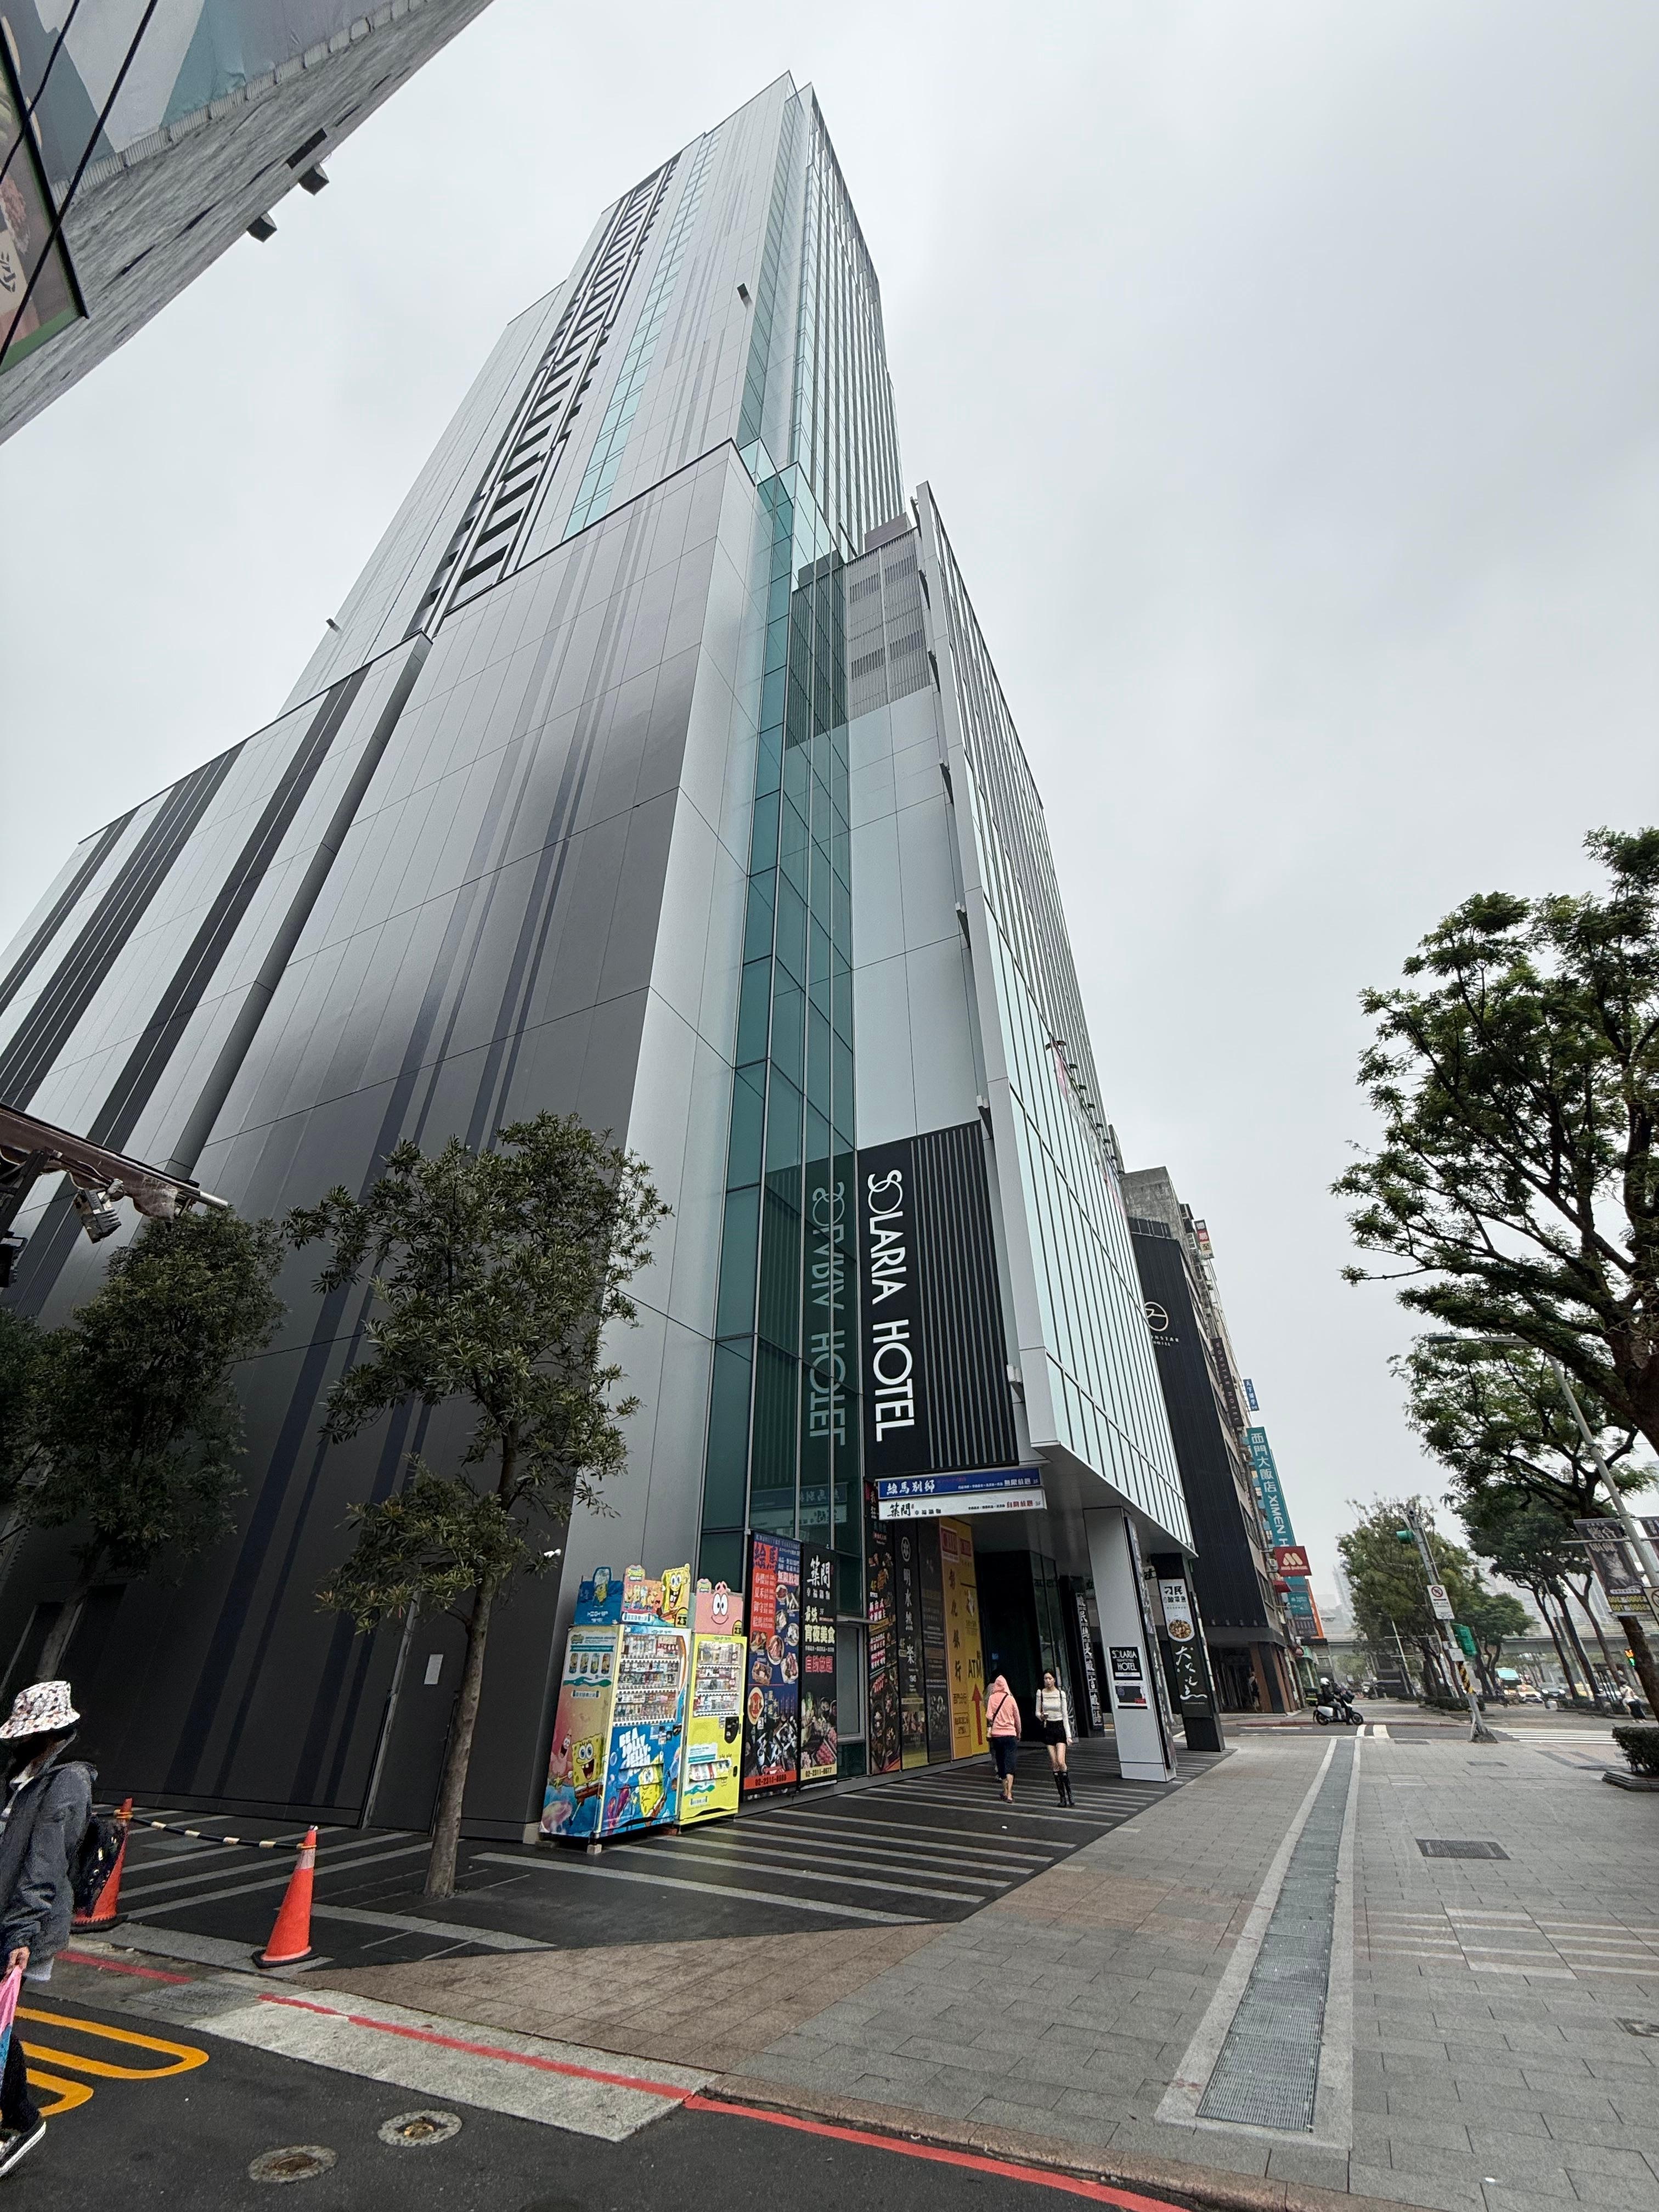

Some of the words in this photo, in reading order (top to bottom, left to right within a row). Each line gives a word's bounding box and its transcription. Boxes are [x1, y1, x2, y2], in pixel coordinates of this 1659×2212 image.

[867, 1170, 907, 1305] SOLARIA
[872, 1319, 915, 1442] HOTEL
[1251, 1432, 1277, 1493] 西門大飯店
[1268, 1495, 1286, 1534] XIMEN
[968, 1659, 982, 1679] ATM
[1111, 1650, 1138, 1659] SOLARIA
[1118, 1662, 1137, 1671] HOTEL
